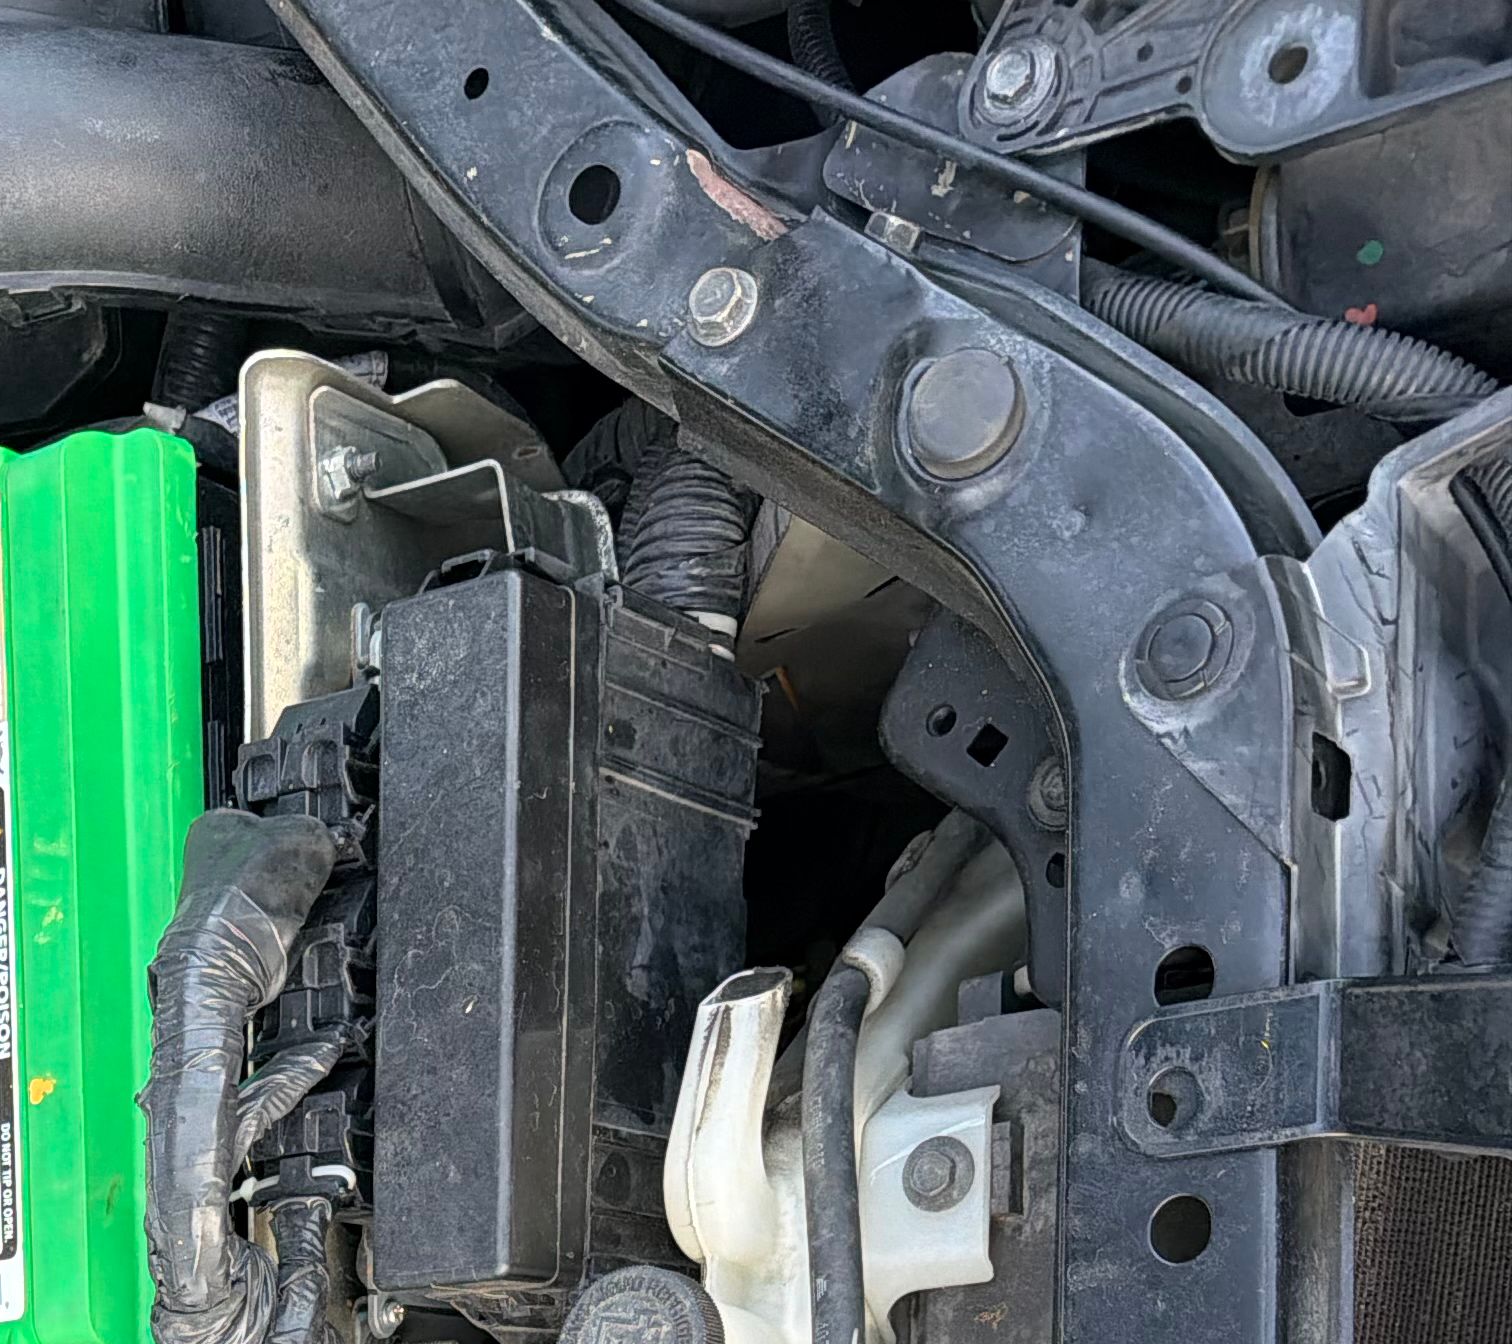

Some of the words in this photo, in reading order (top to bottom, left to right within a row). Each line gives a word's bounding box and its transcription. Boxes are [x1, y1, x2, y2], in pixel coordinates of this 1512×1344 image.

[1, 1122, 11, 1141] DO
[1, 1143, 12, 1167] NOT
[2, 1168, 12, 1187] TIP
[3, 1188, 12, 1207] OR
[3, 1208, 14, 1244] OPEN.
